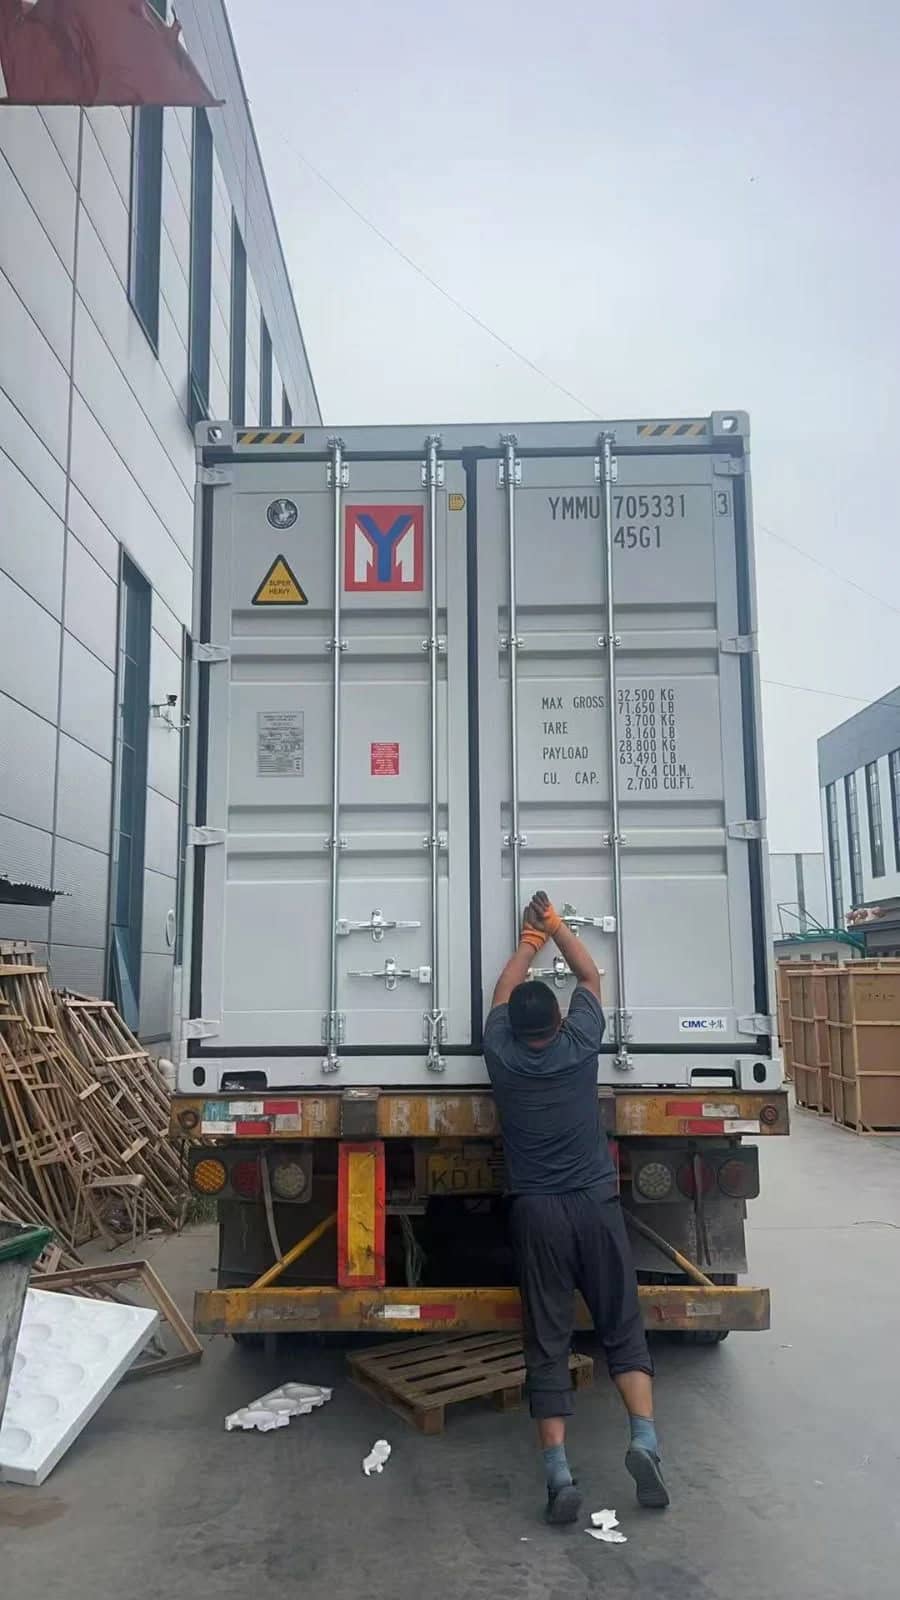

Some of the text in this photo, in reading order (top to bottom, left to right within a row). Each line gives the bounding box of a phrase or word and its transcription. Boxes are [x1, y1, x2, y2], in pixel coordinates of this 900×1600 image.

[548, 492, 729, 520] YMMU 705331 3
[613, 525, 661, 549] 45G1
[660, 688, 674, 701] KG
[542, 696, 605, 710] MAX GROSS
[661, 702, 674, 714] LB
[661, 714, 675, 727] KG
[543, 721, 568, 735] TARE
[661, 726, 675, 739] LB
[662, 739, 676, 752] KG
[543, 746, 589, 760] PAYLOAD
[662, 751, 677, 764] LB
[634, 765, 657, 777] 76.4
[543, 771, 599, 785] CU. CAP.
[681, 1020, 708, 1029] CIMC
